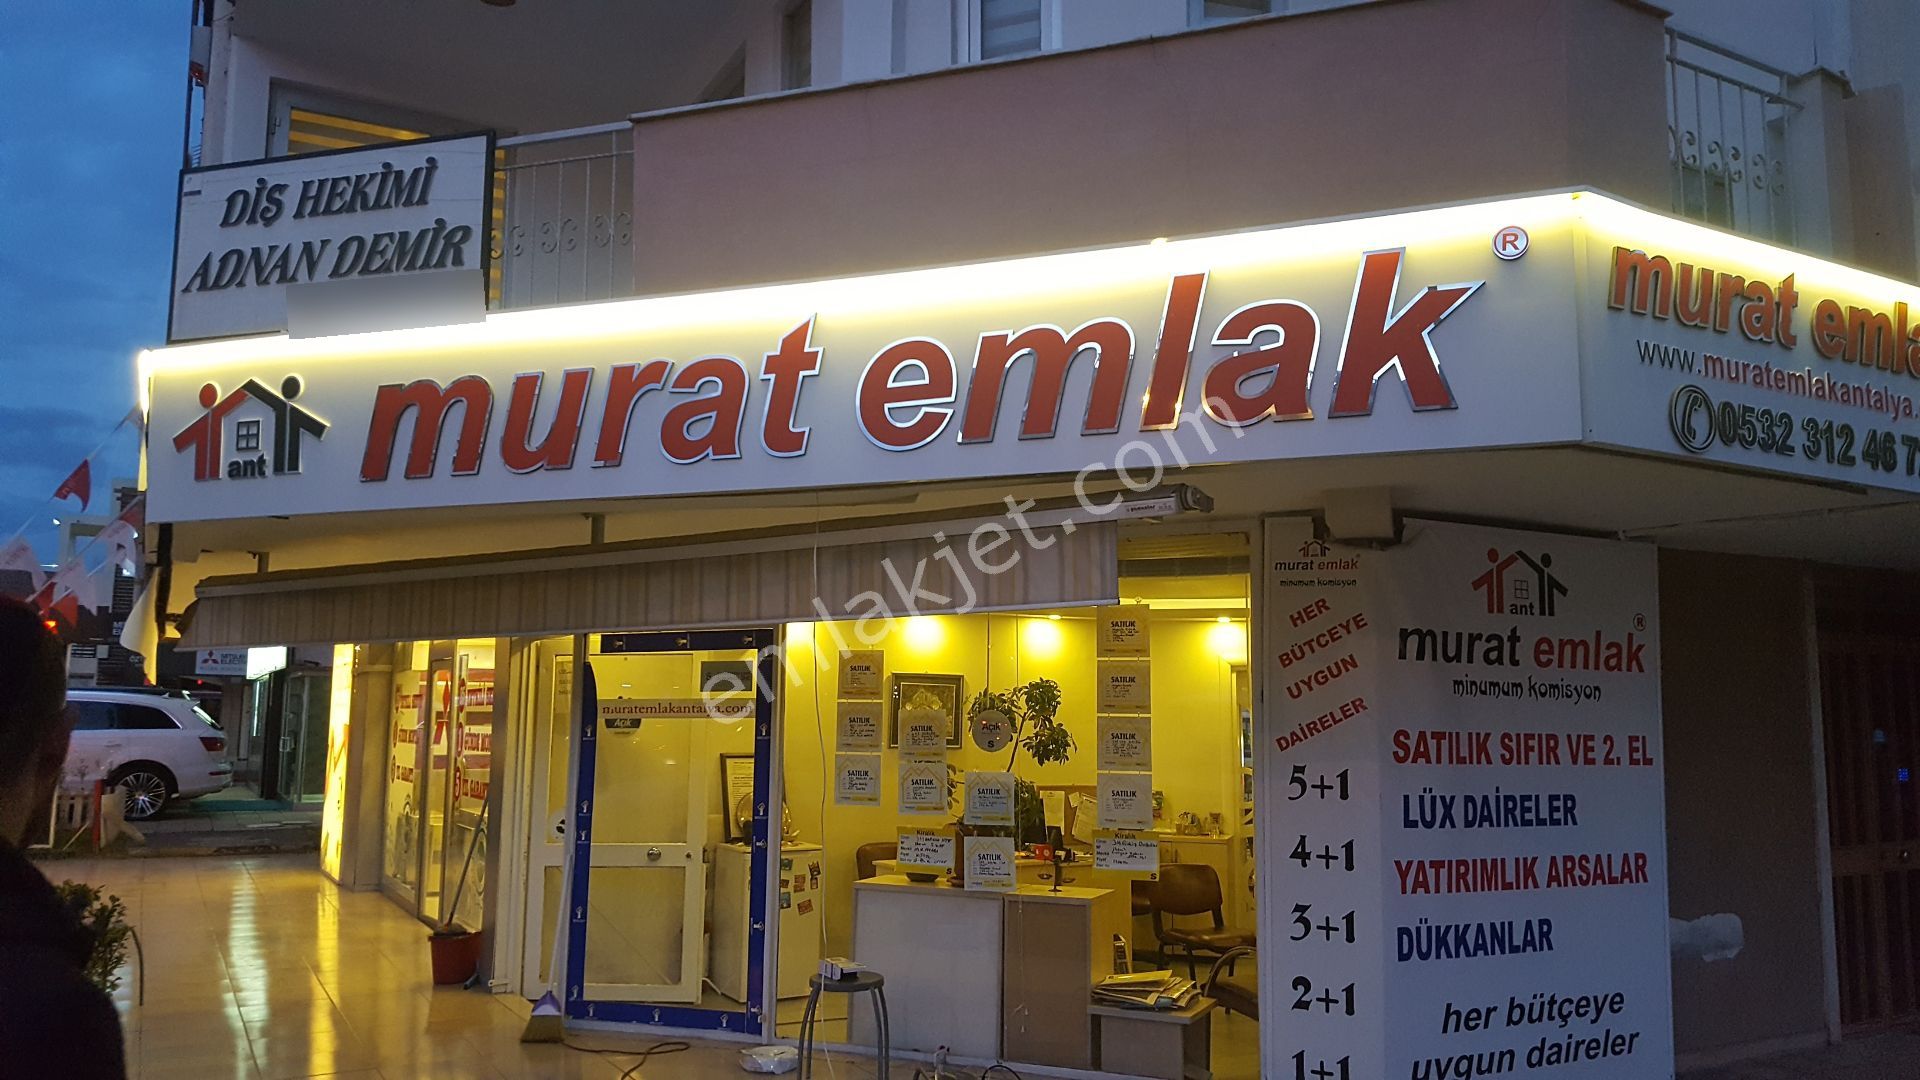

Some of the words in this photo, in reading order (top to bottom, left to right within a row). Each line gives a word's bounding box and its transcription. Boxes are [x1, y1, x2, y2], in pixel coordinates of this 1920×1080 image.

[220, 176, 288, 229] DİŞ
[293, 156, 440, 220] HEKİMİ
[181, 238, 332, 294] ADNAN
[328, 217, 473, 280] DEMİR
[1608, 245, 1799, 349] murat
[359, 312, 824, 482] murat
[856, 246, 1487, 452] emlak
[1637, 339, 1920, 422] www.muratemlakantalya.
[1718, 400, 1796, 457] 0532
[1802, 415, 1857, 468] 312
[1902, 433, 1920, 478] 7
[227, 450, 267, 480] ant
[1274, 559, 1315, 571] murat
[1317, 557, 1359, 570] emlak
[1111, 620, 1136, 628] SATILIK
[1289, 598, 1331, 628] HER
[1509, 601, 1535, 617] ant
[1398, 624, 1521, 667] murat
[1533, 630, 1646, 673] emlak
[1286, 653, 1359, 700] UYGUN
[1452, 674, 1523, 700] minumum
[1528, 674, 1602, 705] komisyon
[602, 701, 752, 718] muratemlakantalya.com
[1275, 697, 1368, 752] DAİRELER
[1111, 732, 1136, 740] SATILIK
[1393, 728, 1493, 766] SATILIK
[1499, 731, 1560, 766] SIFIR
[1566, 733, 1595, 766] VE
[1602, 734, 1622, 766] 2.
[1628, 735, 1654, 767] EL
[1288, 763, 1351, 801] 5+1
[1402, 788, 1457, 829] LÜX
[1463, 785, 1578, 829] DAİRELER
[978, 853, 1001, 861] SATILIK
[1289, 835, 1356, 872] 4+1
[1394, 855, 1539, 895] YATIRIMLIK
[1546, 852, 1649, 888] ARSALAR
[1289, 903, 1357, 944] 3+1
[1396, 917, 1554, 962] DÜKKANLAR
[1291, 976, 1356, 1016] 2+1
[1441, 1002, 1497, 1035] her
[1505, 991, 1625, 1029] bütçeye
[1411, 1047, 1516, 1080] uygun
[1526, 1028, 1640, 1069] daireler
